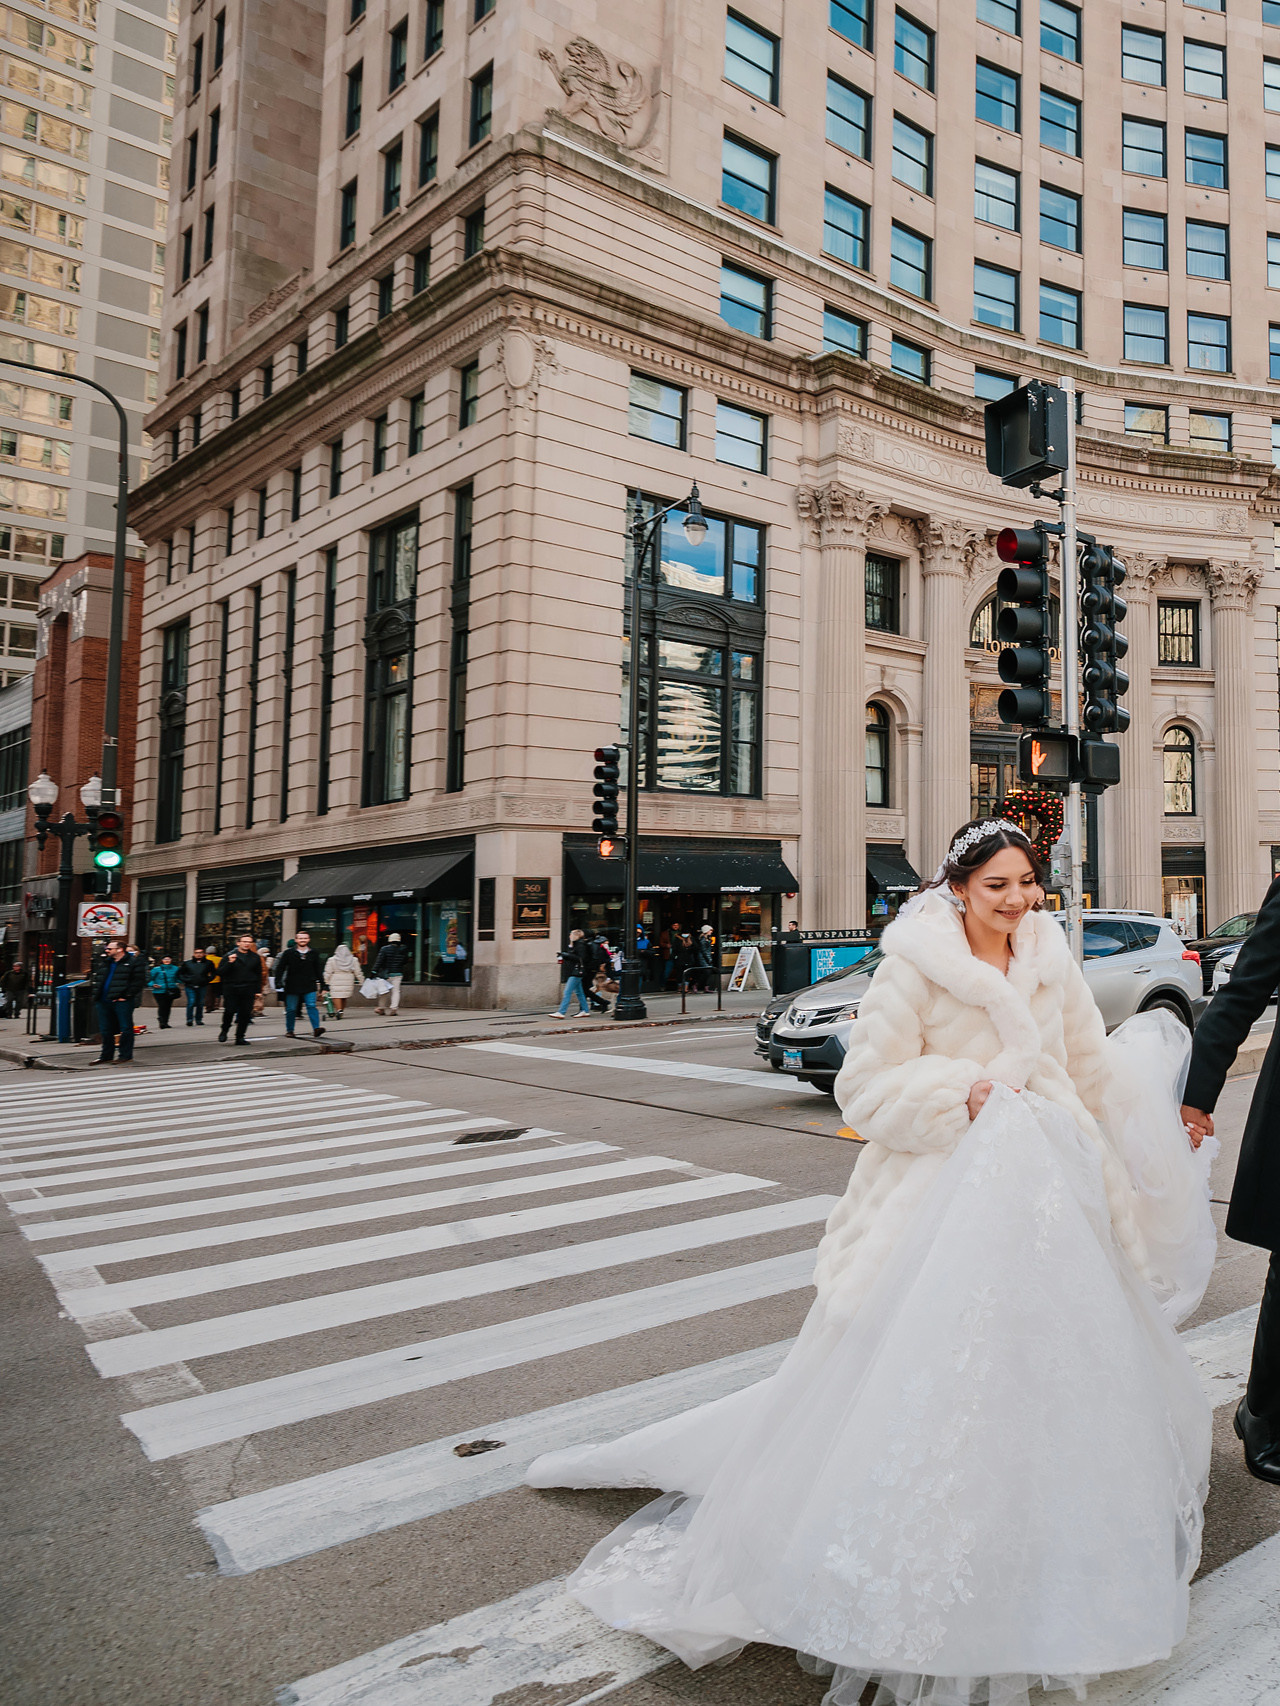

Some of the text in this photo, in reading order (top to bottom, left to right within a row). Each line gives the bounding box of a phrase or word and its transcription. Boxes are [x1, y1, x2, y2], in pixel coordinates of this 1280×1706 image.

[882, 441, 954, 480] LONDON
[960, 468, 1030, 499] GVARAN
[1076, 495, 1158, 521] ACCIDENT
[523, 884, 541, 893] 360
[636, 885, 680, 893] mashburger
[720, 885, 761, 893] smashburger
[800, 929, 872, 939] NEWSPAPERS
